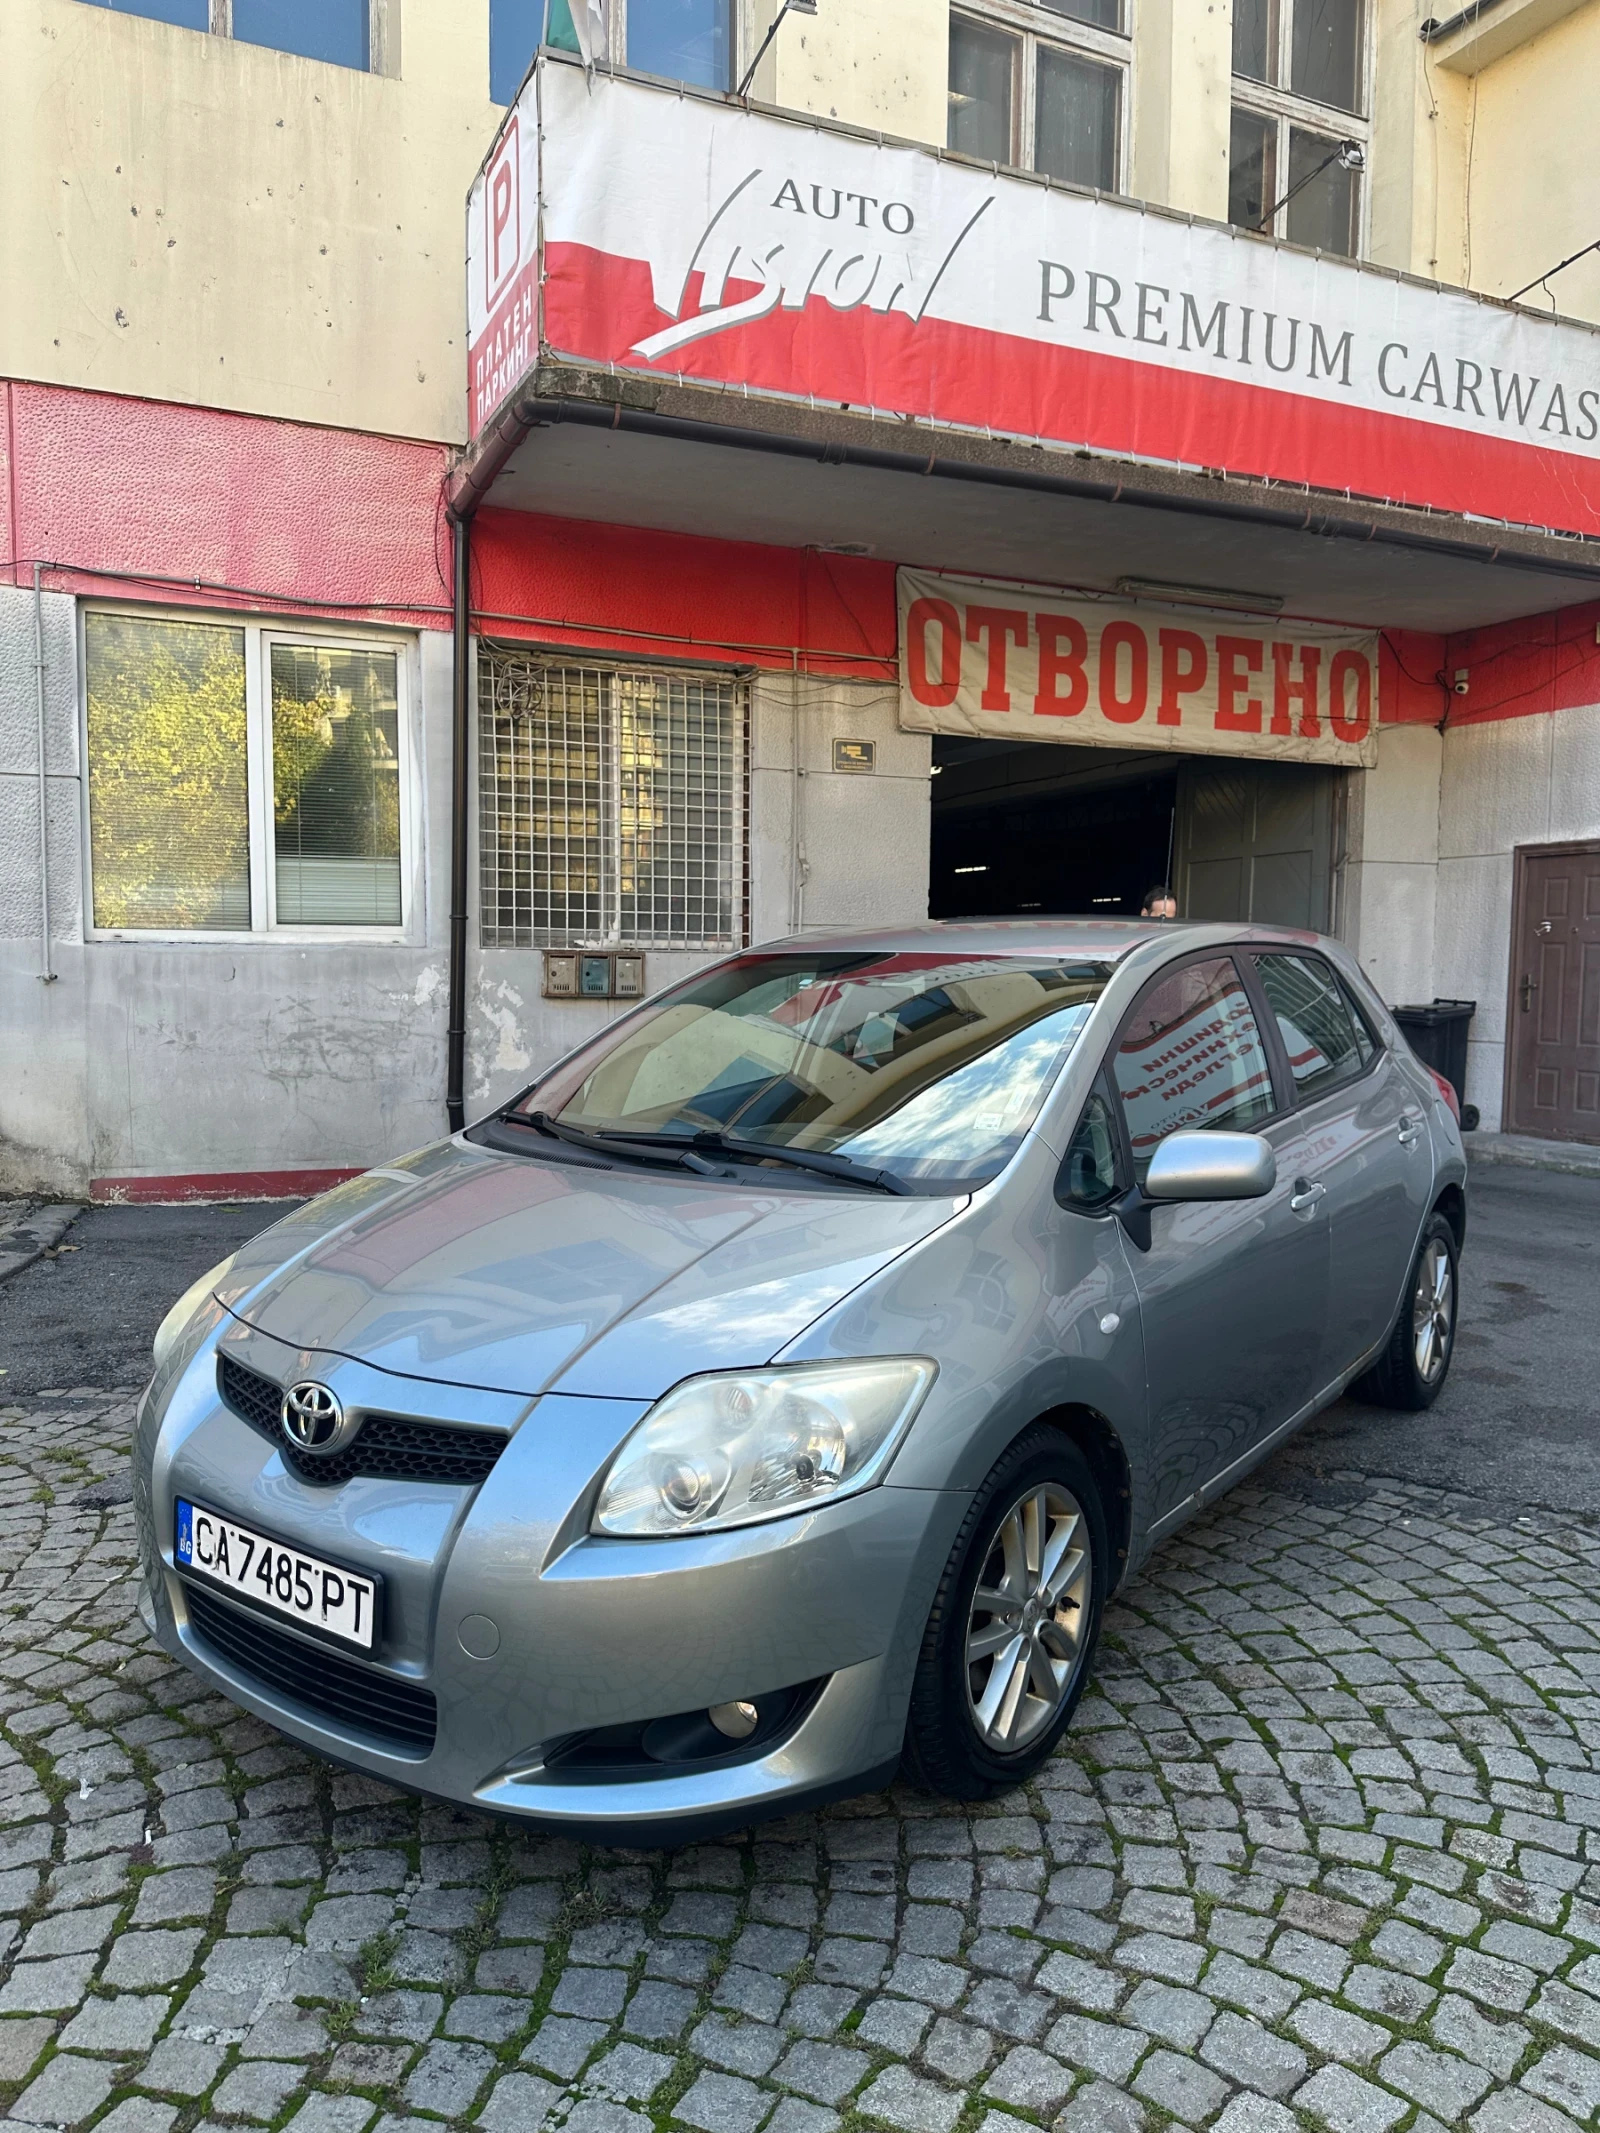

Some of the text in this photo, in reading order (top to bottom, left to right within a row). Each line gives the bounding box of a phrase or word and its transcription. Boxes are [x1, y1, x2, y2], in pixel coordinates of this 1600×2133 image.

[770, 178, 915, 234] AUTO
[475, 284, 532, 388] ПЛАТЕН
[476, 323, 532, 424] ПАРКИНГ
[1036, 259, 1354, 387] PREMIUM
[906, 597, 1371, 743] ОТВОРЕНО
[180, 1537, 191, 1555] BG
